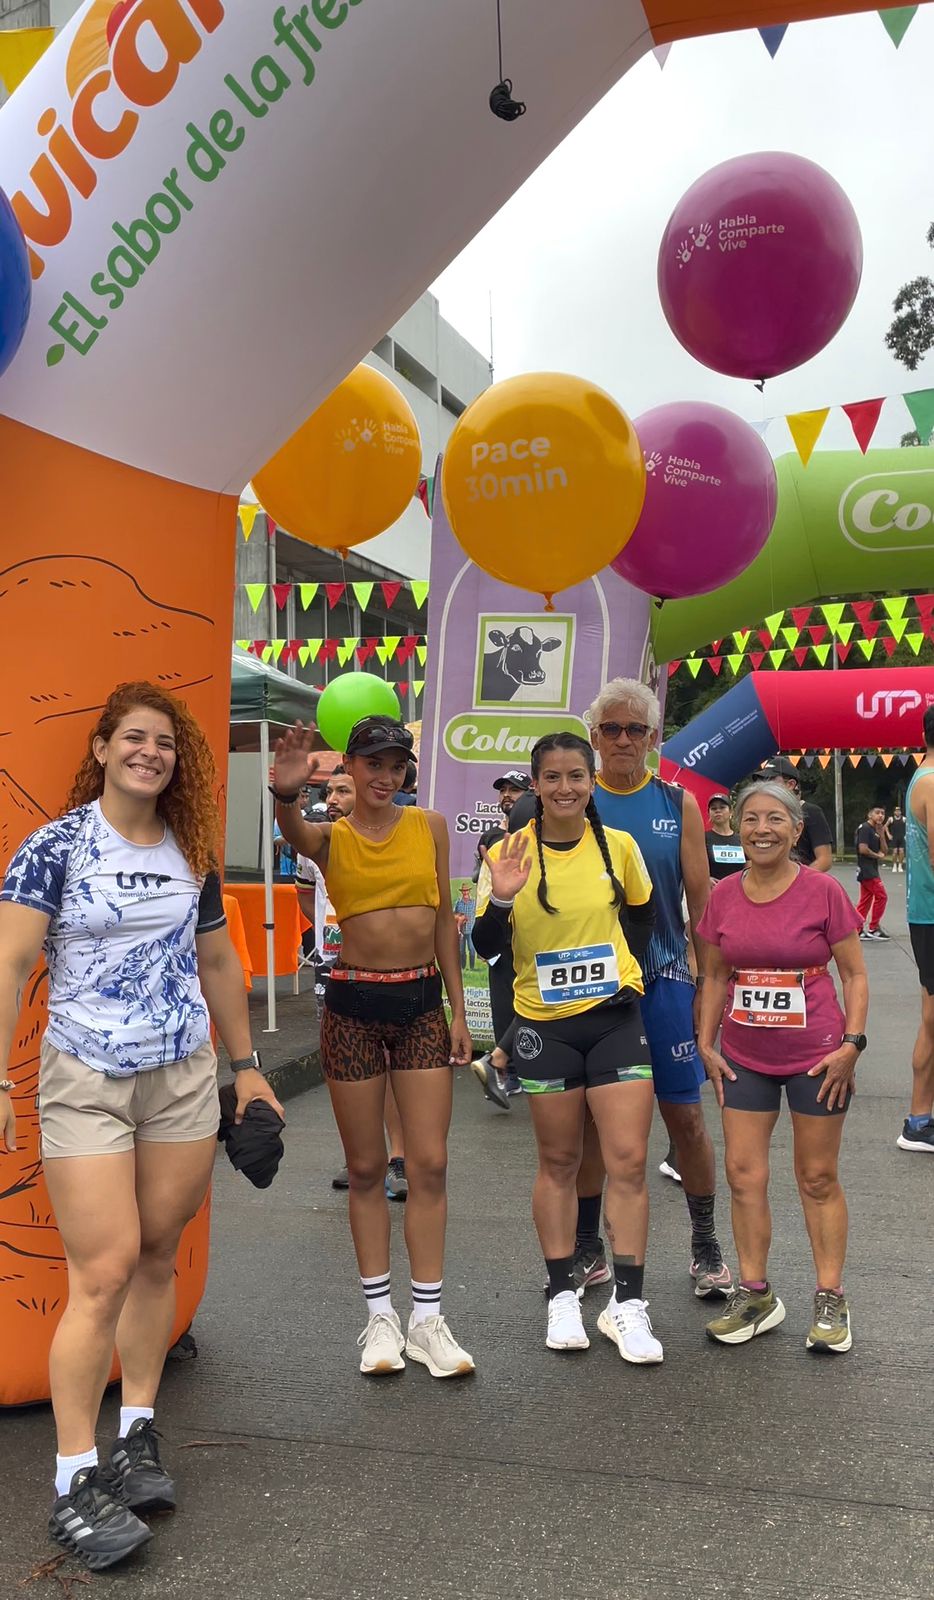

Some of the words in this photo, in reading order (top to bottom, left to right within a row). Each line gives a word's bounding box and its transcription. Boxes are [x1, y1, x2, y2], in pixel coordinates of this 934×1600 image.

[10, 0, 225, 281] uica
[48, 291, 108, 356] El
[90, 168, 194, 309] sabor
[186, 109, 246, 183] de
[223, 55, 291, 118] la
[273, 0, 362, 87] fre
[719, 214, 757, 230] Habla
[718, 224, 785, 240] Comparte
[719, 239, 747, 253] Vive
[471, 436, 551, 470] Pace
[668, 455, 701, 470] Habla
[464, 462, 568, 503] 30min
[663, 474, 688, 488] Vive
[665, 464, 721, 487] Comparte
[852, 489, 934, 534] Co
[856, 689, 922, 719] UTP
[683, 742, 709, 767] UTP
[476, 803, 503, 814] Lact
[456, 814, 502, 833] Sem
[652, 818, 678, 832] UTP
[116, 871, 172, 889] UTP
[551, 962, 605, 987] 809
[467, 989, 484, 998] High
[586, 986, 604, 994] UTP
[742, 990, 791, 1010] 648
